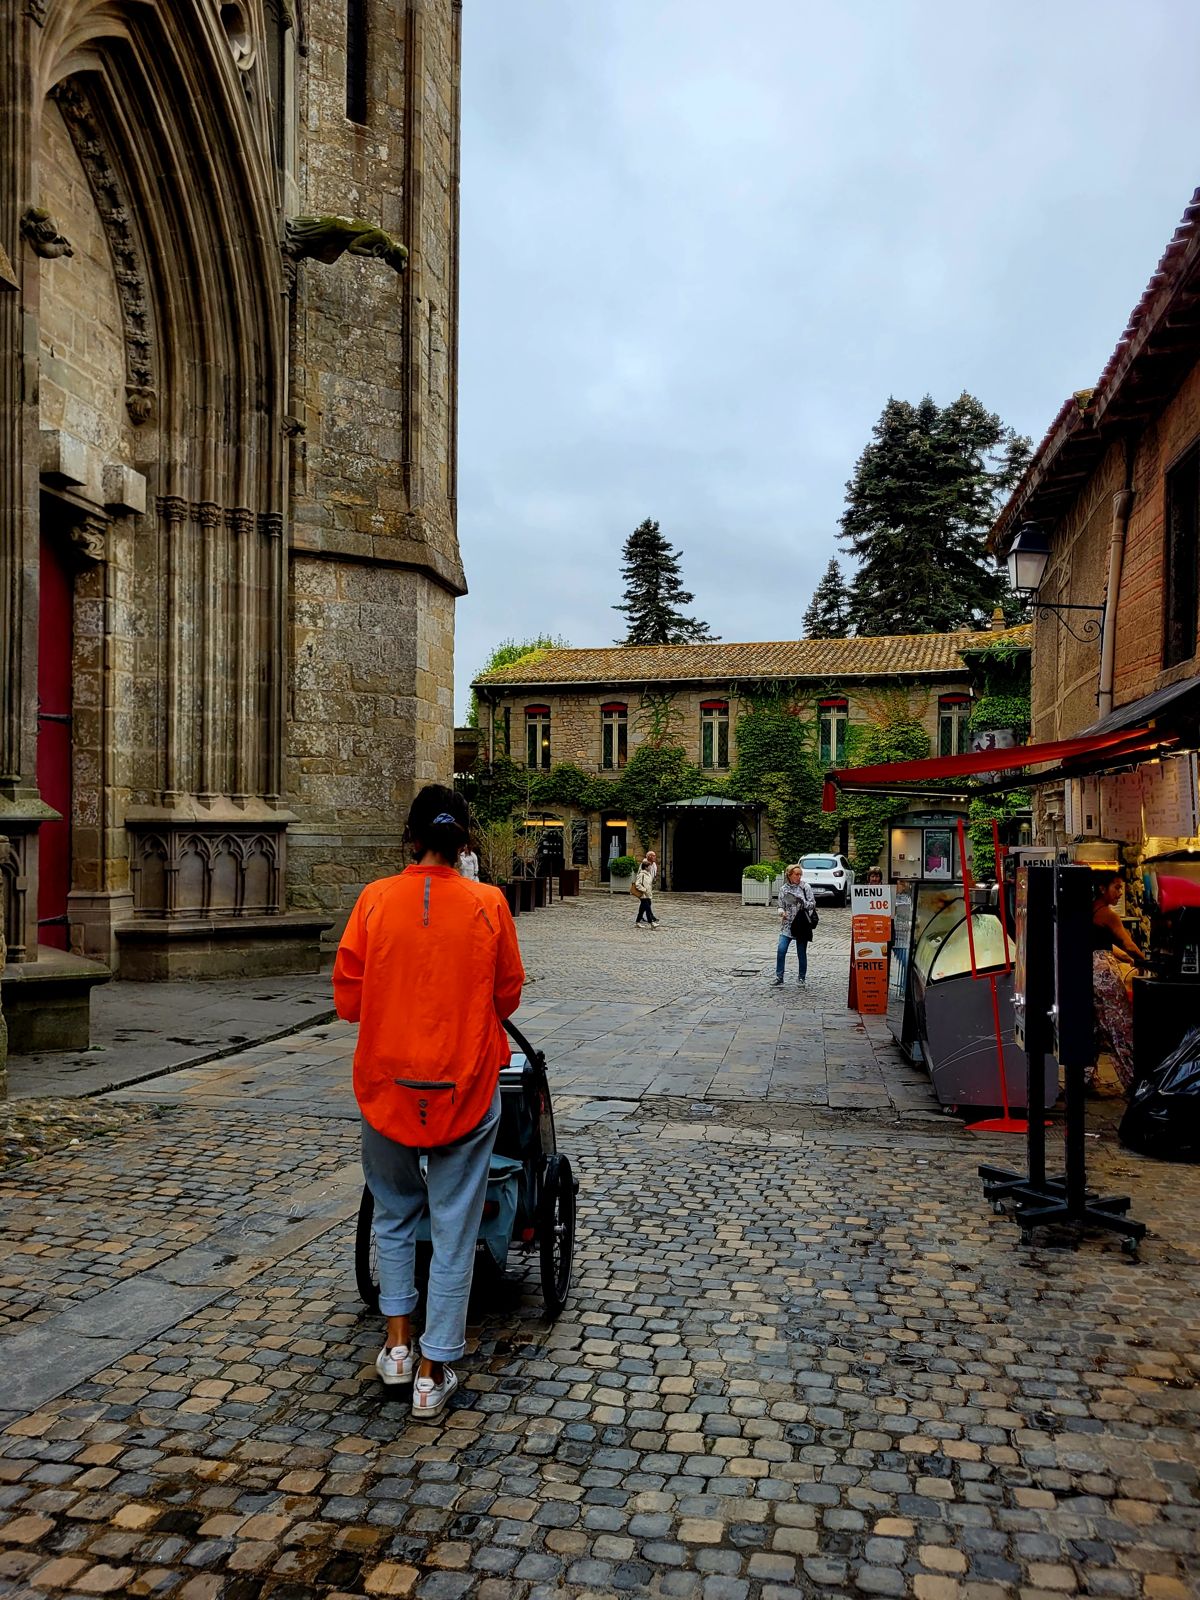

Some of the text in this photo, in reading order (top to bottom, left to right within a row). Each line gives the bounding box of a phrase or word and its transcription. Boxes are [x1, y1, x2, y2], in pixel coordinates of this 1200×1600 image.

[1023, 859, 1054, 867] MENU
[854, 888, 883, 897] MENU
[869, 900, 889, 910] 10€
[857, 961, 884, 971] FRITE
